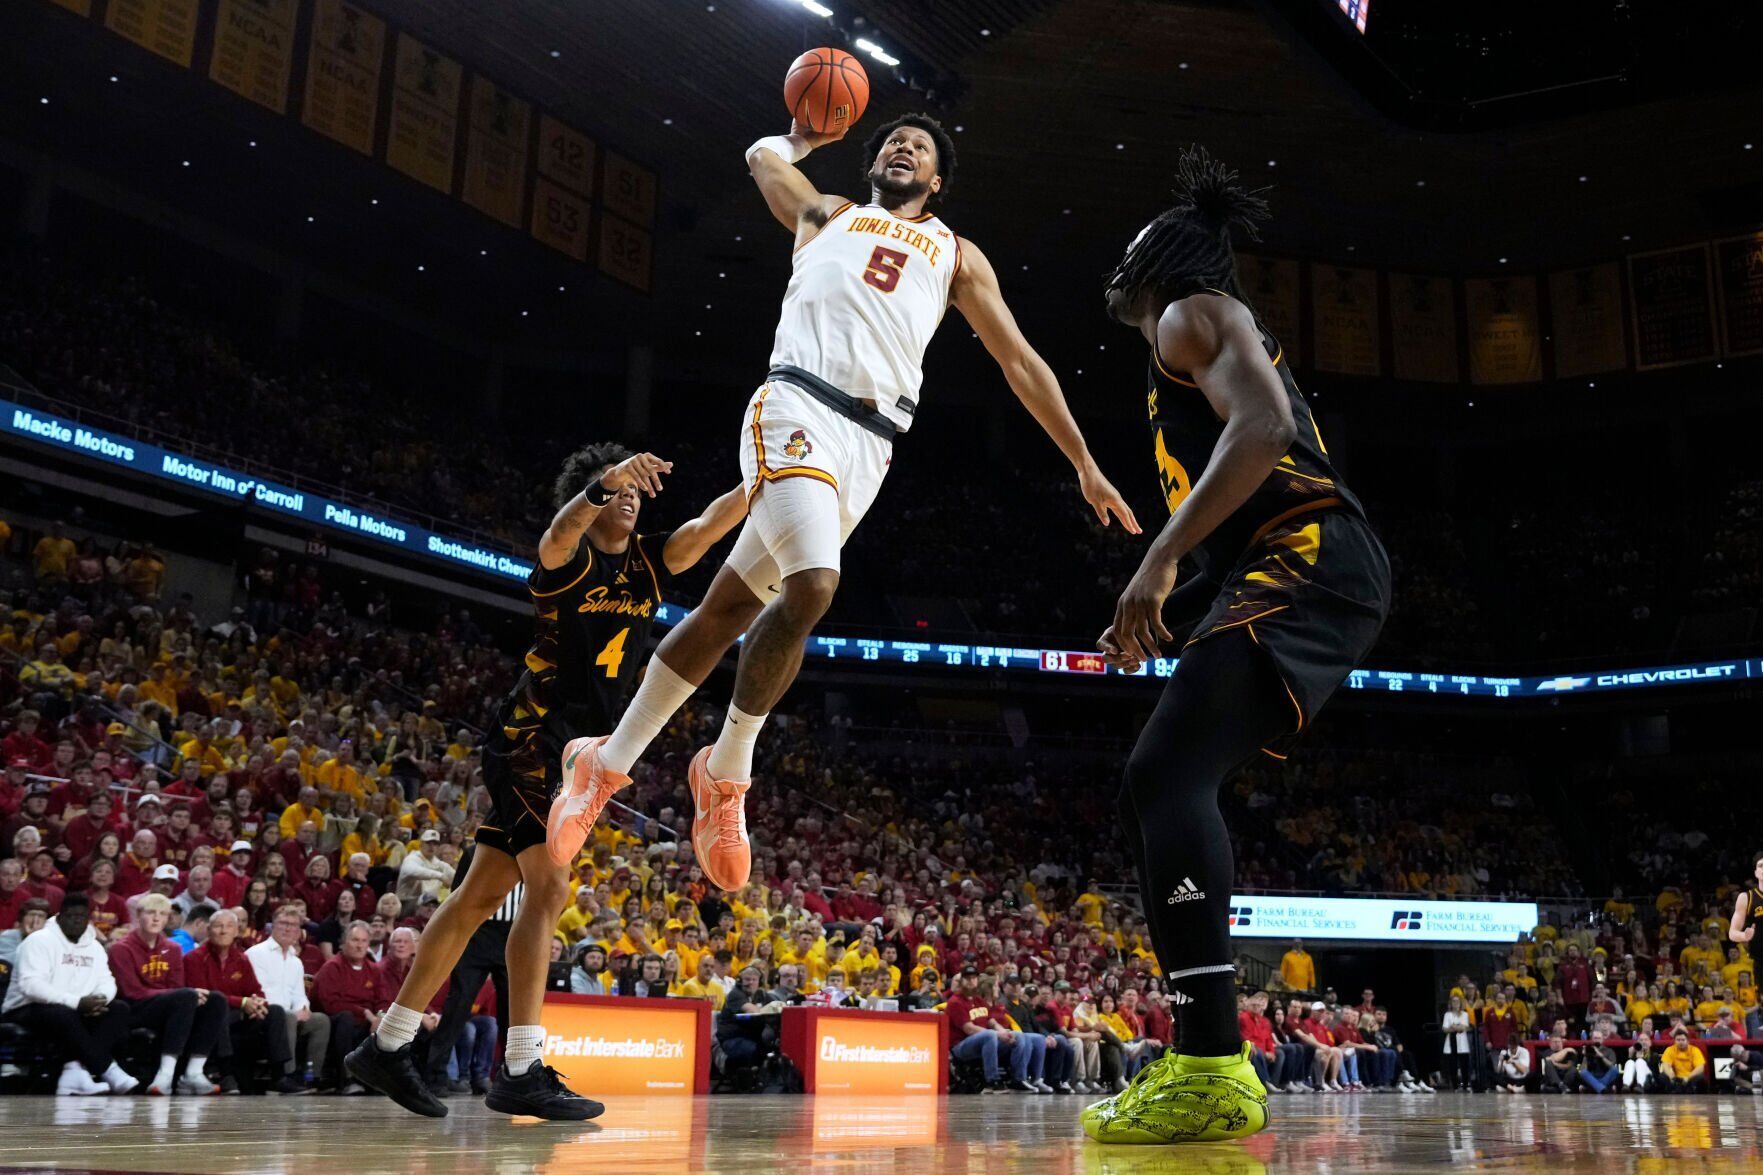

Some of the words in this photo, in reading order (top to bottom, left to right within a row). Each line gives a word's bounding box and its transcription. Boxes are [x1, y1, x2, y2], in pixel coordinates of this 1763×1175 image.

[551, 134, 583, 169] 42
[847, 217, 891, 236] IOWA
[891, 223, 941, 267] STATE
[863, 245, 909, 294] 5
[13, 410, 73, 443] Macke
[74, 429, 135, 461] Motors
[162, 456, 210, 484] Motor
[211, 470, 236, 492] Inn
[255, 484, 304, 512] Carroll
[325, 505, 358, 528] Pella
[360, 515, 406, 542] Motors
[428, 536, 497, 570] Shottenkirk
[595, 627, 631, 678] 4
[857, 639, 884, 649] STEALS
[827, 644, 836, 657] 1
[863, 647, 879, 660] 13
[903, 650, 919, 662] 25
[946, 652, 962, 665] 16
[981, 655, 990, 667] 2
[999, 656, 1009, 668] 4
[1045, 651, 1069, 671] 61
[1350, 677, 1364, 689] 11
[1388, 679, 1403, 691] 22
[1428, 681, 1438, 693] 4
[1460, 683, 1469, 695] 4
[1494, 685, 1509, 697] 18
[1378, 671, 1413, 681] REBOUNDS
[1420, 673, 1445, 683] STEALS
[1451, 675, 1477, 684] BLOCKS
[1483, 677, 1521, 686] TURNOVERS
[1597, 665, 1736, 687] CHEVROLET
[1167, 891, 1206, 905] adidas
[1256, 907, 1286, 916] FARM
[1288, 908, 1328, 917] BUREAU
[1426, 911, 1453, 920] FARM
[1457, 912, 1493, 921] BUREAU
[1256, 918, 1309, 928] FINANCIAL
[1312, 919, 1357, 929] SERVICES
[1426, 922, 1475, 932] FINANCIAL
[1480, 922, 1522, 932] SERVICES
[545, 1035, 583, 1057] First
[583, 1036, 654, 1059] Interstate
[655, 1038, 686, 1059] Bank
[834, 1044, 861, 1063] First
[860, 1044, 910, 1063] Interstate
[910, 1046, 931, 1063] Bank
